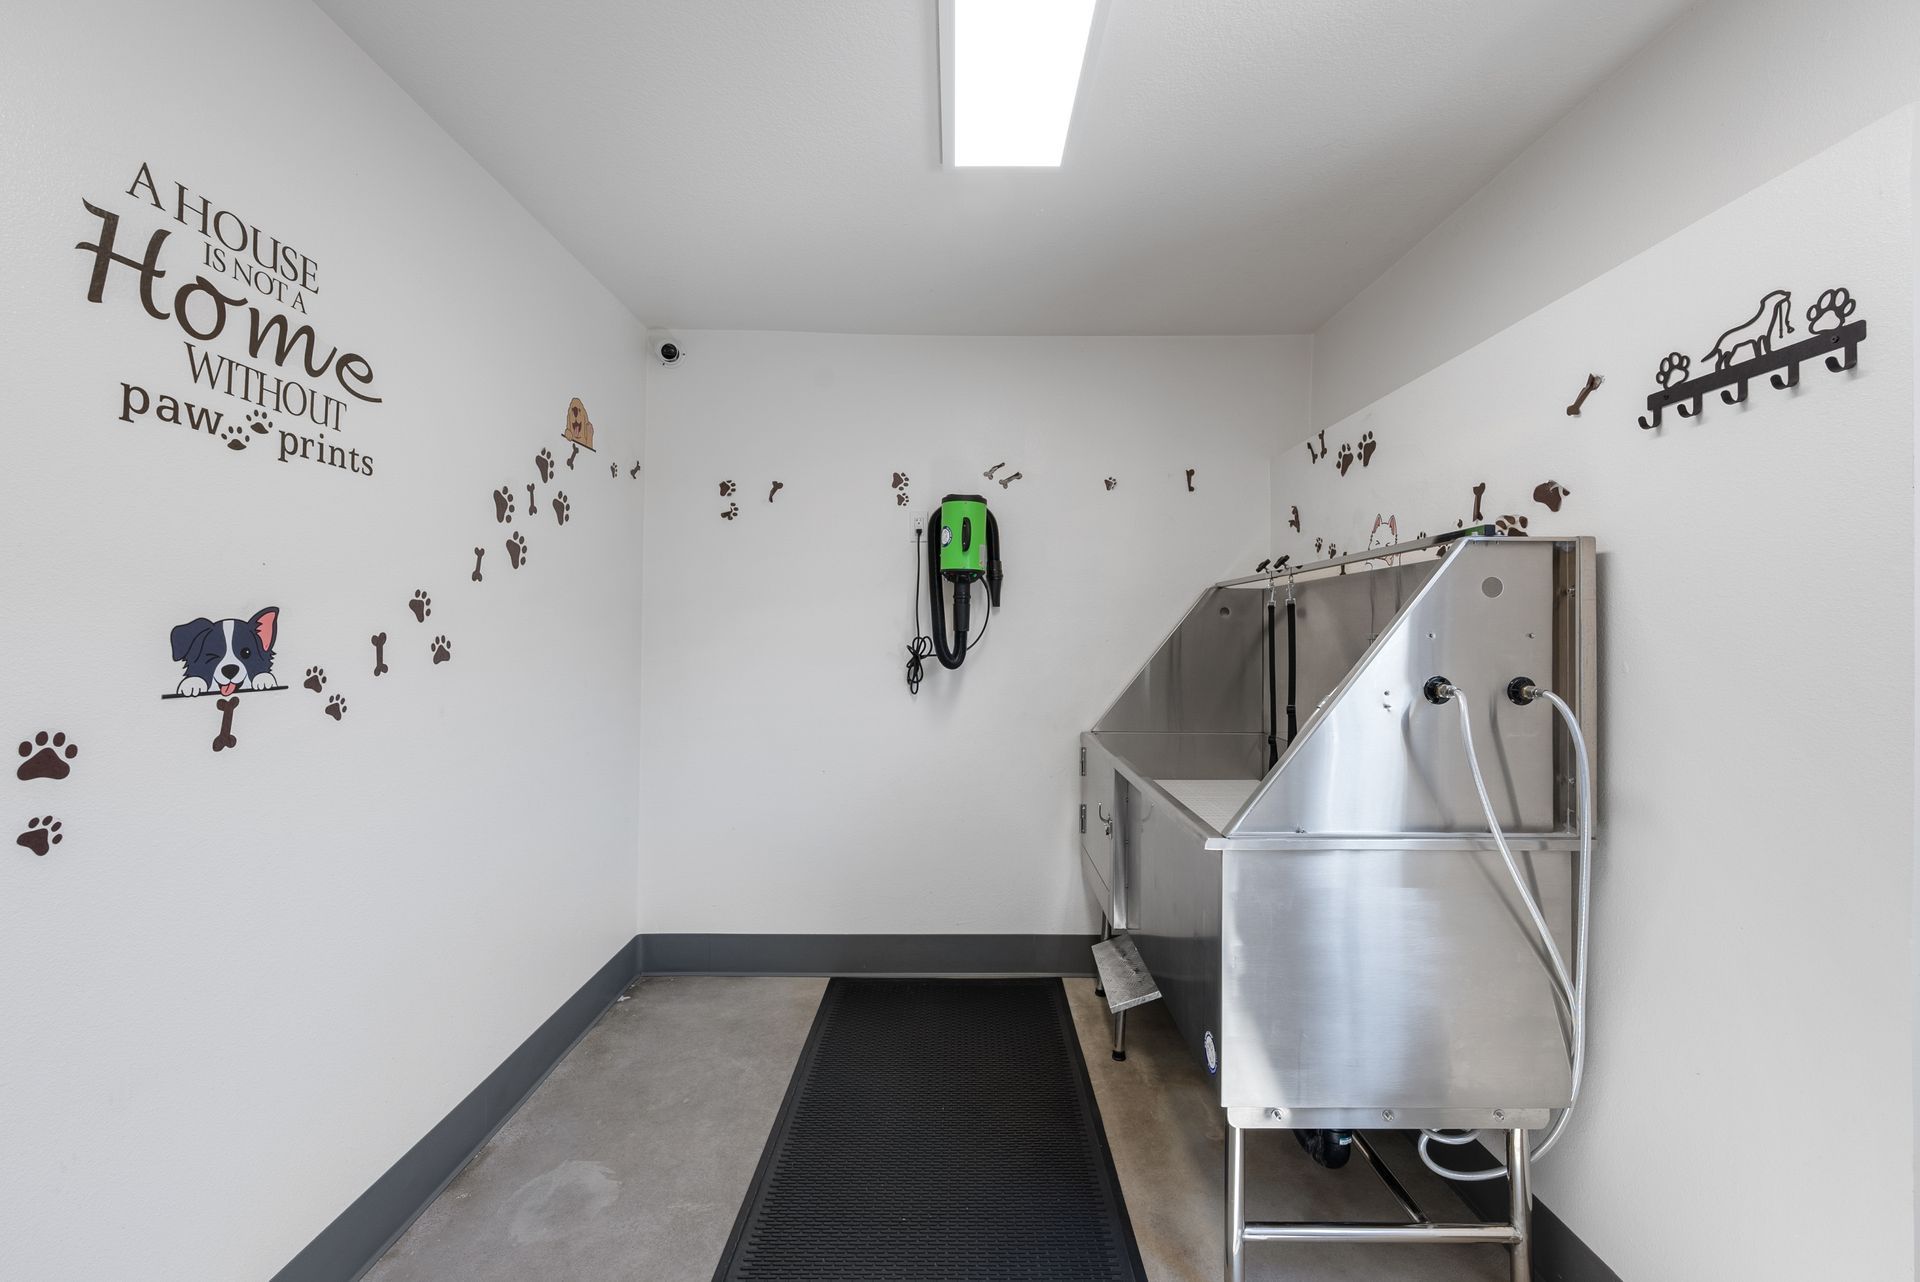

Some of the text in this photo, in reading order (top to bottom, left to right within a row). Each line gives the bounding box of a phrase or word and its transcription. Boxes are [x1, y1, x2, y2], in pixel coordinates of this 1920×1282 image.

[125, 161, 321, 295] A HOUSE
[75, 196, 383, 404] Home
[203, 241, 308, 315] IS NOT A
[118, 381, 375, 477] paw prints
[183, 341, 349, 433] WITHOUT
